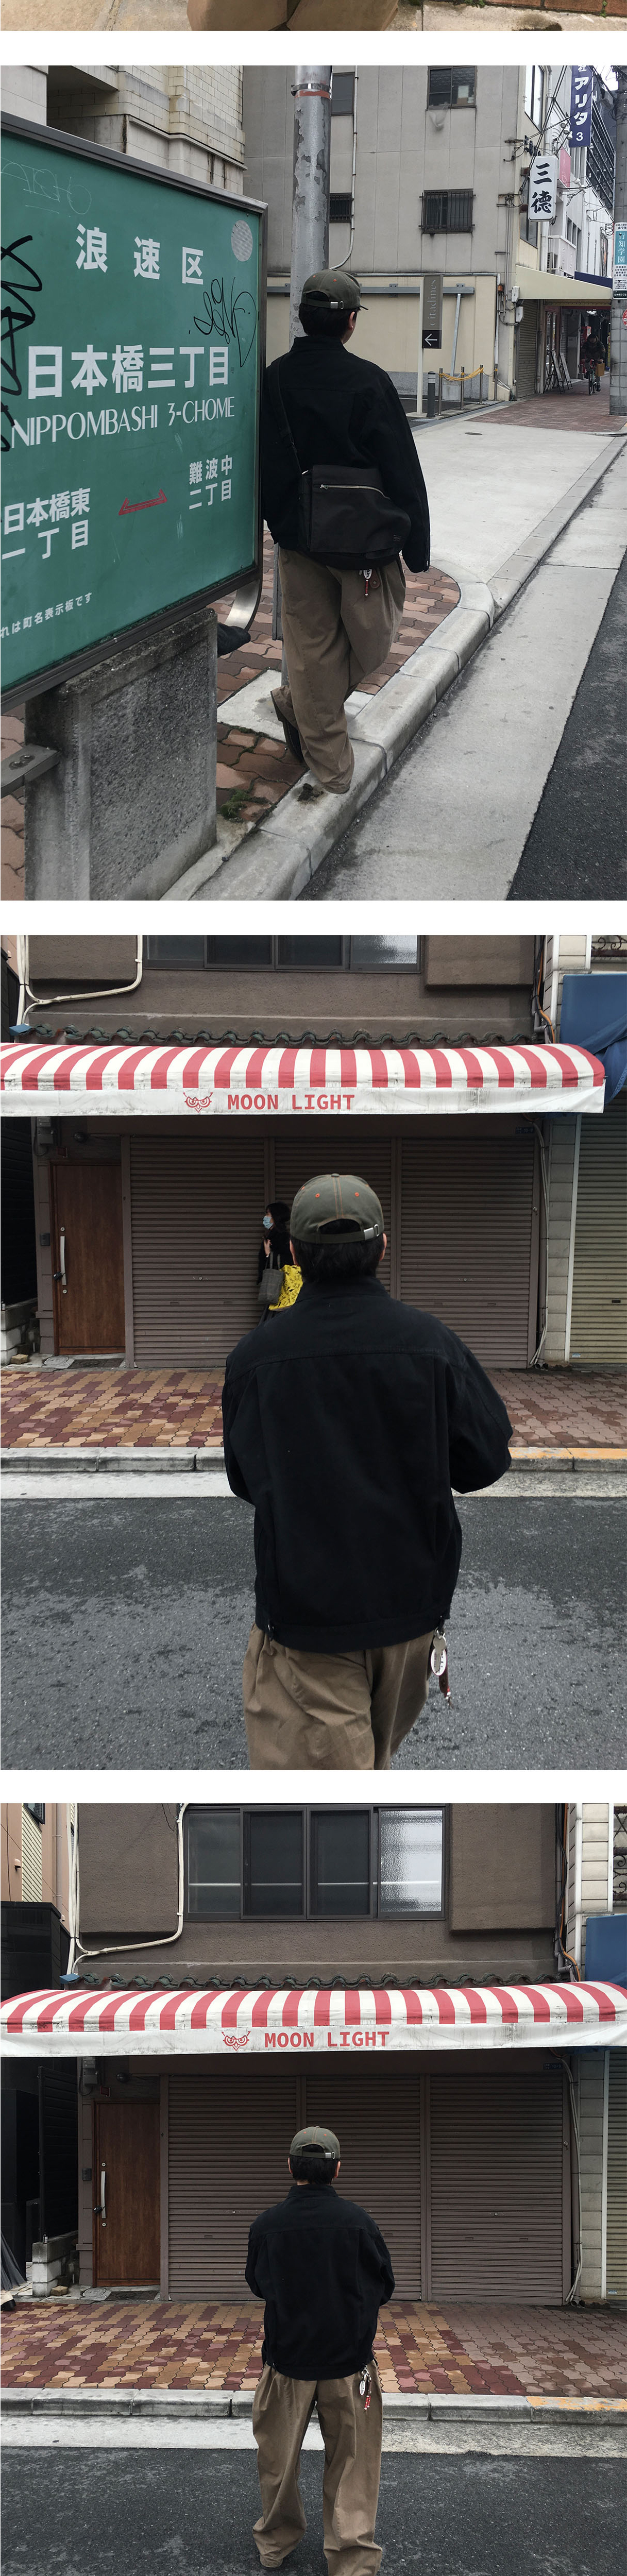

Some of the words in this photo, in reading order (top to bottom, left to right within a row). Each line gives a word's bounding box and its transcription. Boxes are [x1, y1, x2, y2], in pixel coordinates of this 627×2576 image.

[76, 223, 204, 285] 浪速区
[427, 280, 437, 326] citadines
[28, 344, 228, 399] 日本橋三丁目
[11, 404, 158, 448] NIPPOMBASHI
[167, 396, 235, 426] 3-CHOME
[189, 454, 232, 485] 難波中
[4, 488, 91, 535] 日本橋東
[189, 479, 231, 510] 二丁目
[2, 519, 89, 560] 一丁目
[0, 592, 92, 638] れは町名表示板です
[228, 1094, 278, 1110] MOON
[292, 1094, 355, 1110] LIGHT
[264, 2032, 314, 2048] MOON
[327, 2031, 389, 2047] LIGHT
